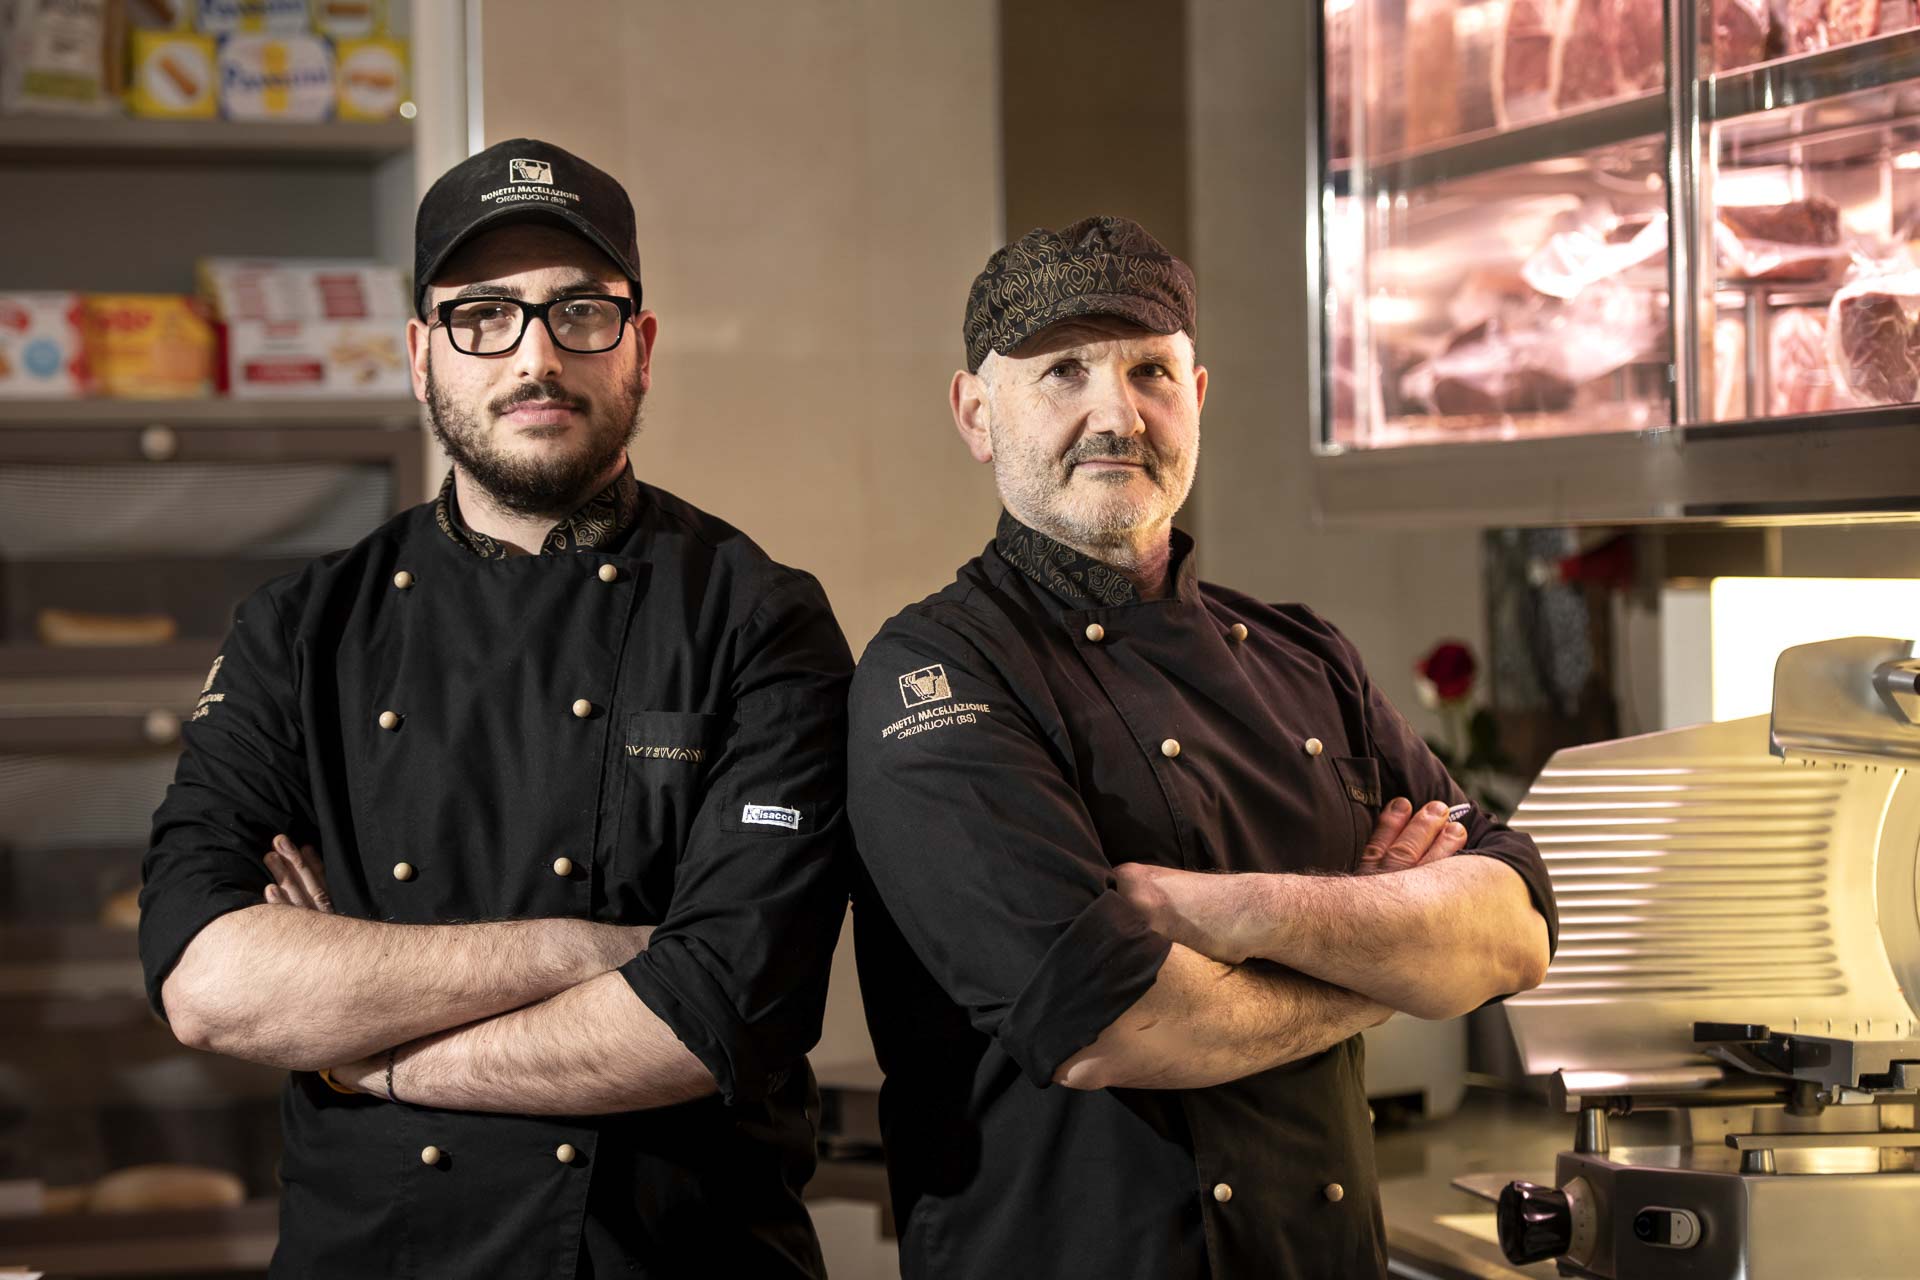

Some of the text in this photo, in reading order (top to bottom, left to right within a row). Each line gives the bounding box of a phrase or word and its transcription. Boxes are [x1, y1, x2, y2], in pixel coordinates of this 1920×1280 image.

[481, 186, 580, 202] BONETTI MACELLAZIONE
[496, 193, 549, 203] ORZINUOVI
[881, 703, 990, 738] BONETTI MACELLAZIONE
[897, 713, 977, 739] ORZINUOVI (BS)
